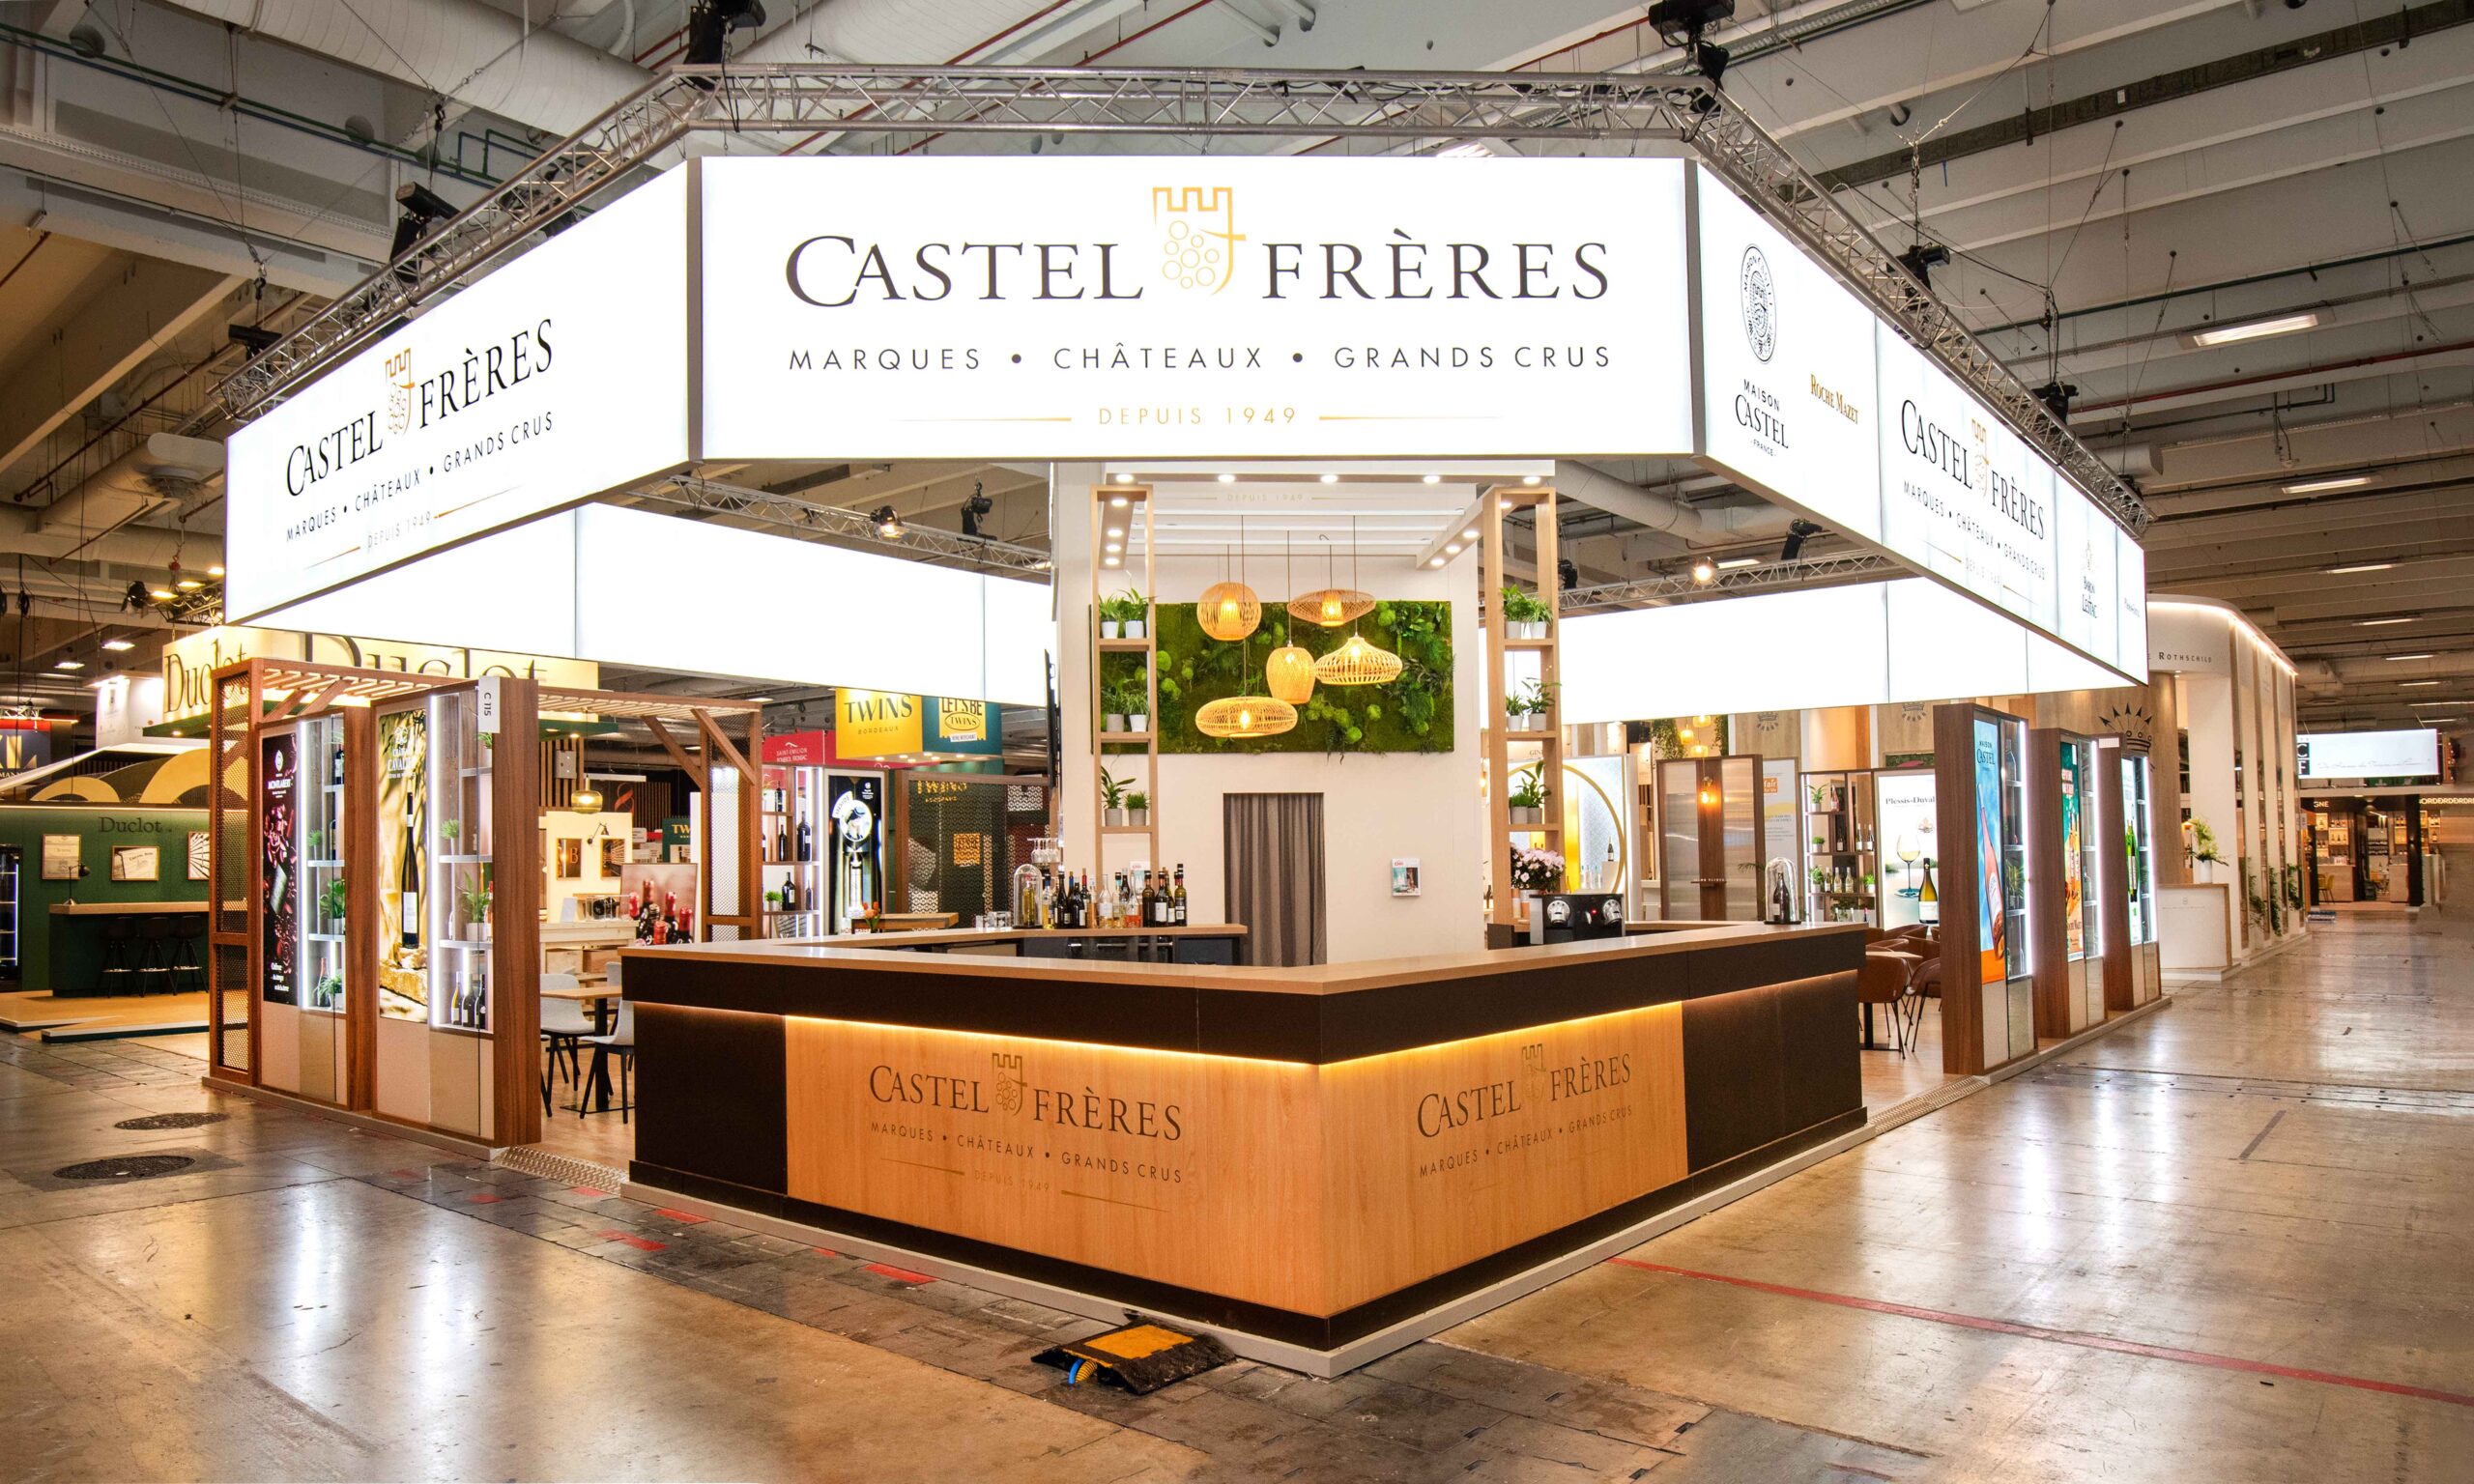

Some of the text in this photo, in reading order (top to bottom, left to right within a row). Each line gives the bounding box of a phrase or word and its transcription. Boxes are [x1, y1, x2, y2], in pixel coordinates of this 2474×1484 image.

[784, 227, 1610, 308] CASTEL FRÈRES
[789, 341, 1612, 373] MARQUES CHÂTEAUX GRANDS CRUS
[286, 318, 554, 498] CASTEL FRÈRES
[1743, 378, 1780, 412] MAISON
[1098, 406, 1296, 426] DEPUIS 1949
[1735, 393, 1789, 449] CASTEL
[286, 412, 554, 542] MARQUES CHÂTEAUX GRANDS CRUS
[1901, 399, 2045, 541] CASTEL FRÈRES
[1904, 480, 1944, 517] MARQUES
[2158, 651, 2212, 664] ROTHSCHILD
[483, 702, 492, 717] 115
[844, 695, 913, 724] TWINS
[951, 716, 977, 726] TWINS
[857, 726, 899, 735] BORDEAUX
[99, 816, 162, 834] Duclot
[870, 1065, 1182, 1141] CASTEL FRÈRES
[1417, 1053, 1631, 1138] CASTEL FRÈRES
[871, 1121, 1182, 1184] MARQUES CHÂTEAUX GRANDS CRUS
[1420, 1104, 1632, 1179] MARQUES CHÂTEAUX GRANDS CRUS
[974, 1169, 1050, 1192] DEPUIS 1949
